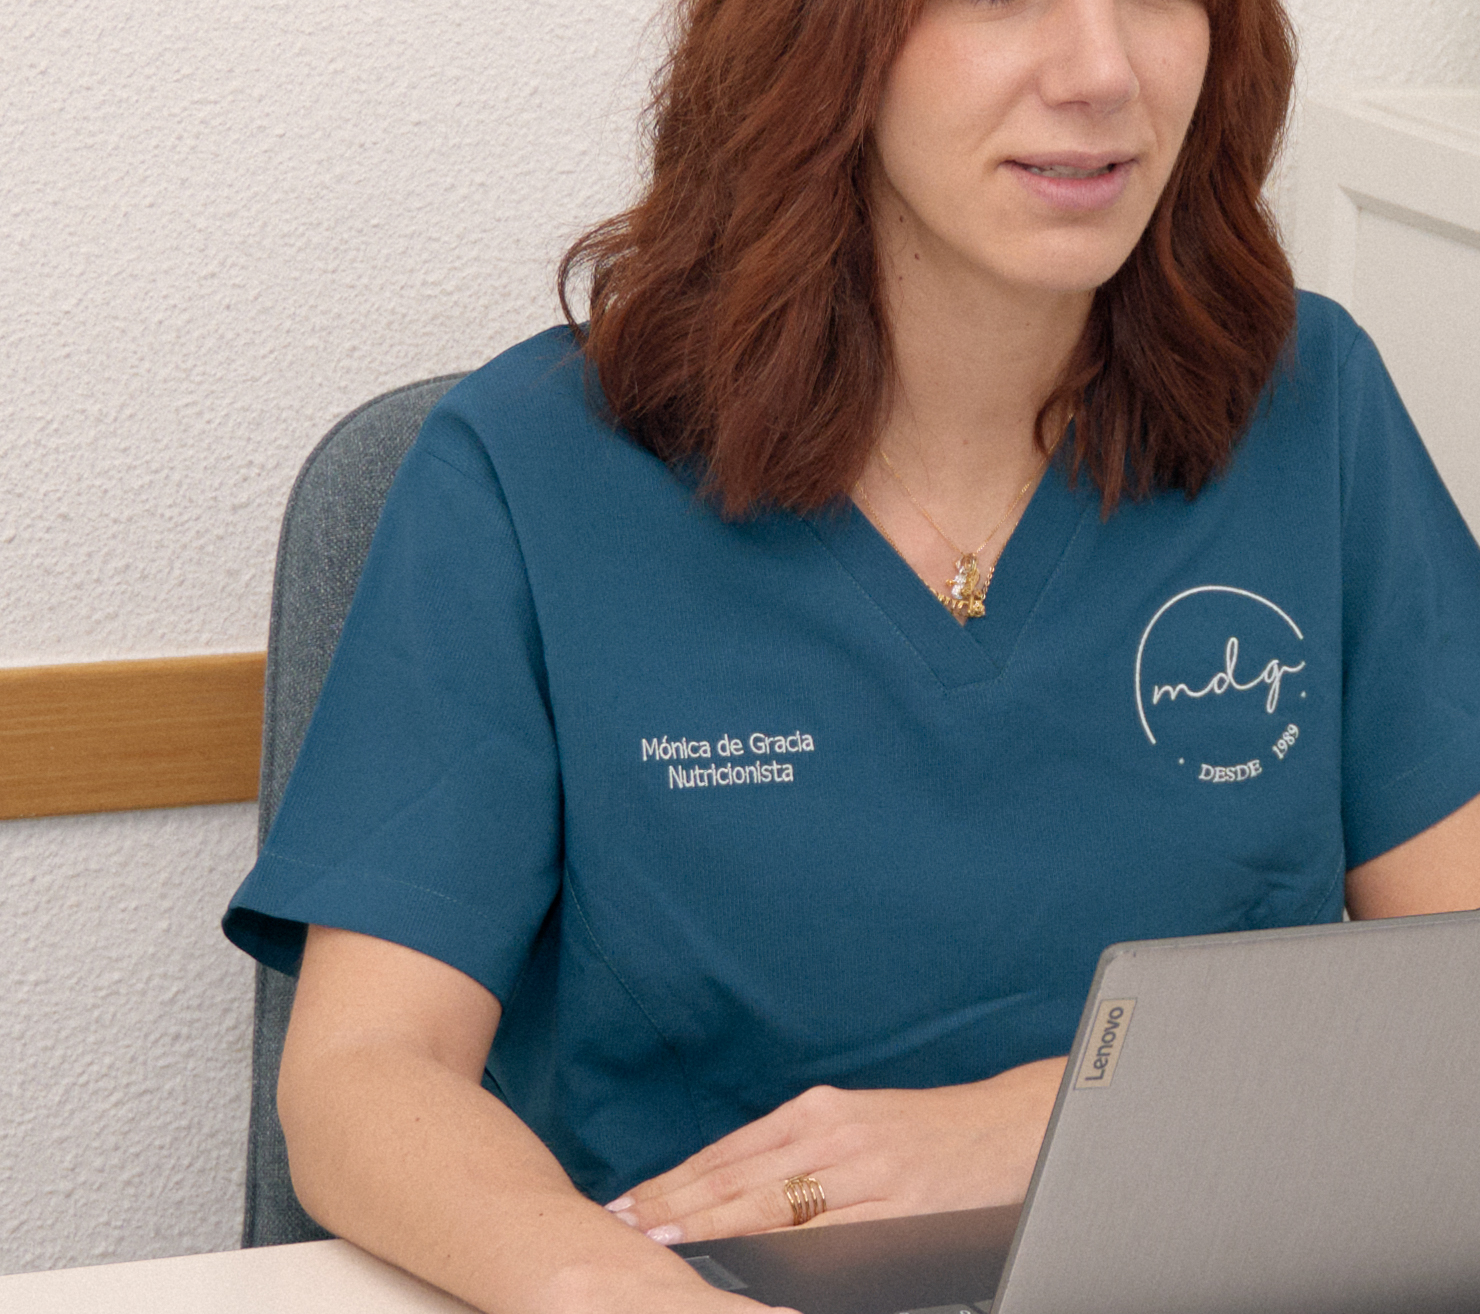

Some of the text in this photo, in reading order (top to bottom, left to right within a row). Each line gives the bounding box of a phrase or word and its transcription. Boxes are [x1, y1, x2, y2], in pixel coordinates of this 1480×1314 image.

[641, 730, 815, 762] Mónica de Gracia
[1198, 723, 1300, 783] DESDE 1989
[668, 760, 794, 789] Nutricionista
[1084, 1006, 1125, 1081] Lenovo
